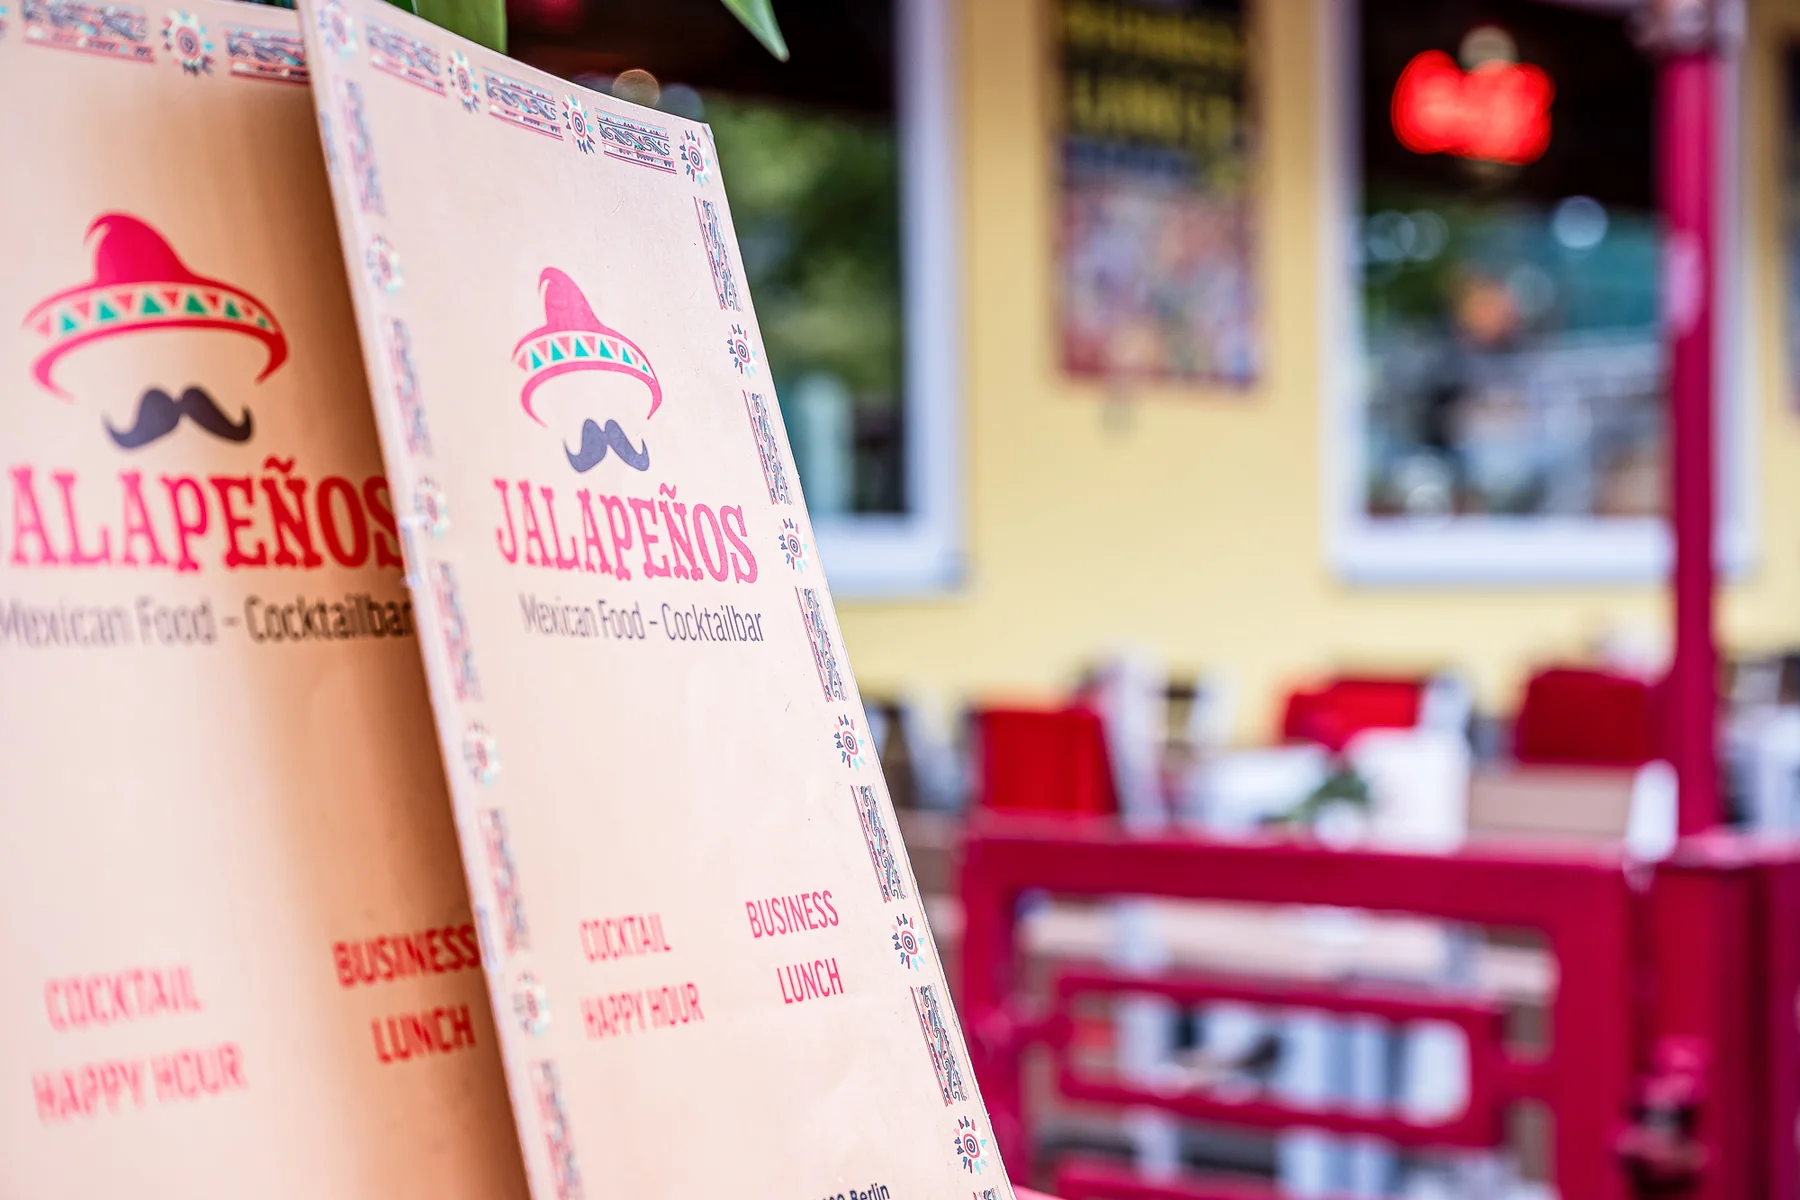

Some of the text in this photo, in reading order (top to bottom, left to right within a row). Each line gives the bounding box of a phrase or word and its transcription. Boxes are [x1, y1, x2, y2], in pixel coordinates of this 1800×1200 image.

[0, 454, 403, 573] ALAPEÑOS
[493, 478, 758, 583] JALAPEÑOS
[0, 596, 129, 647] Mexican
[135, 595, 216, 644] Food
[245, 592, 414, 641] Cocktailbar
[519, 592, 598, 638] Mexican
[598, 599, 646, 640] Food
[661, 603, 763, 642] Cocktailbar
[579, 913, 671, 962] COCKTAIL
[746, 889, 839, 939] BUSINESS
[332, 923, 480, 989] BUSINESS
[777, 957, 844, 1004] LUNCH
[44, 966, 203, 1031] COCKTAIL
[579, 982, 704, 1039] HAPPY HOUR
[371, 1003, 476, 1064] LUNCH
[32, 1041, 247, 1124] HAPPY HOUR
